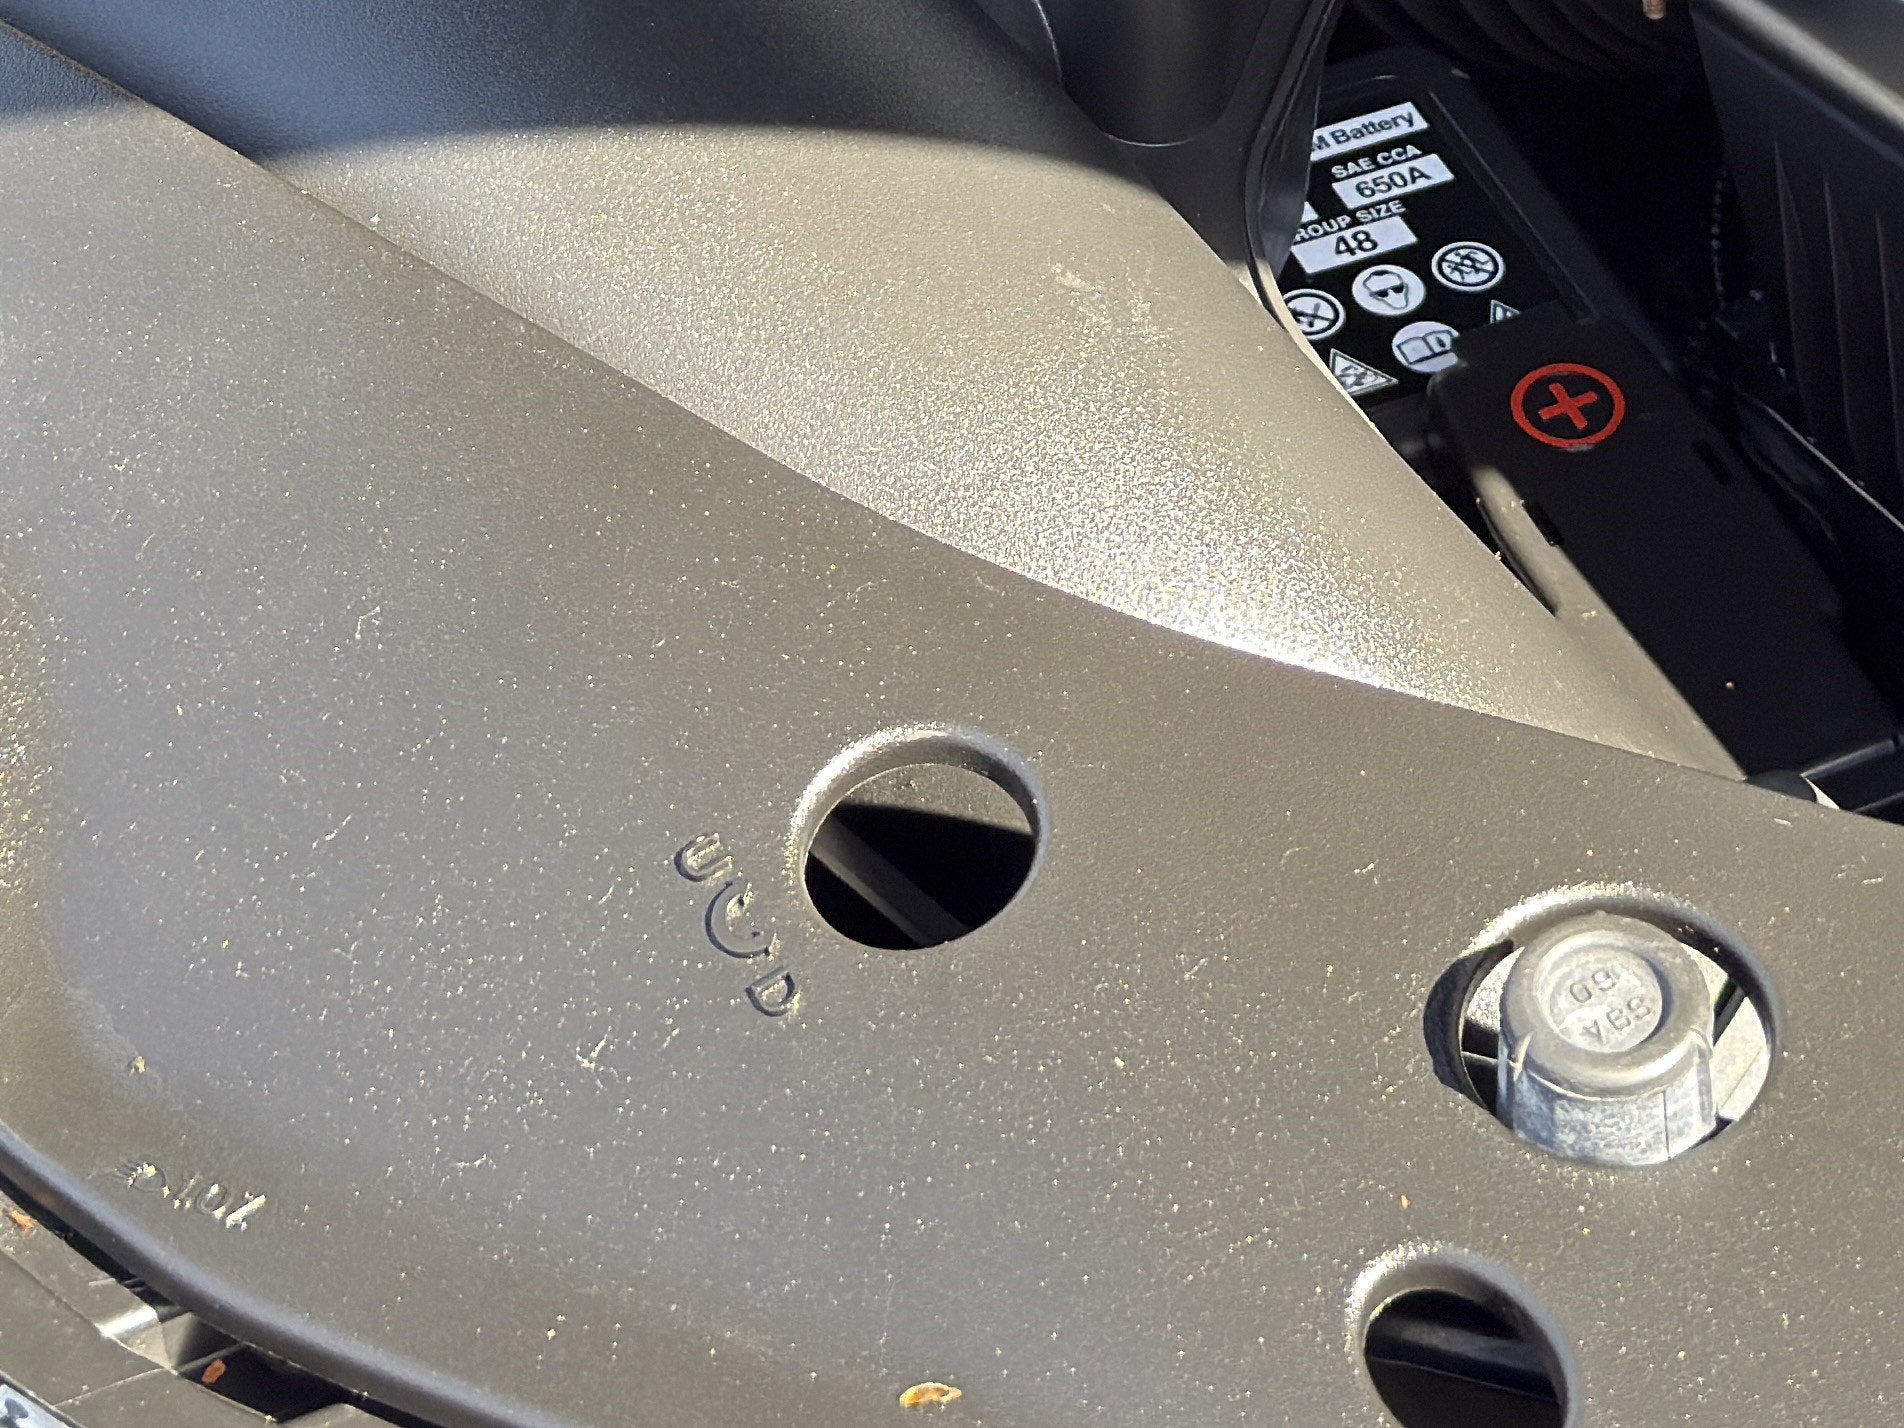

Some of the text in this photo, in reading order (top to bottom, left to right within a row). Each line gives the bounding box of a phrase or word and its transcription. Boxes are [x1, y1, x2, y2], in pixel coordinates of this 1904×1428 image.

[1329, 110, 1415, 145] Battery
[1331, 144, 1423, 180] SAE CCA
[1354, 165, 1433, 199] 650A
[1293, 199, 1407, 243] ROUP SIZE
[1334, 229, 1379, 257] 48
[744, 966, 801, 1017] D
